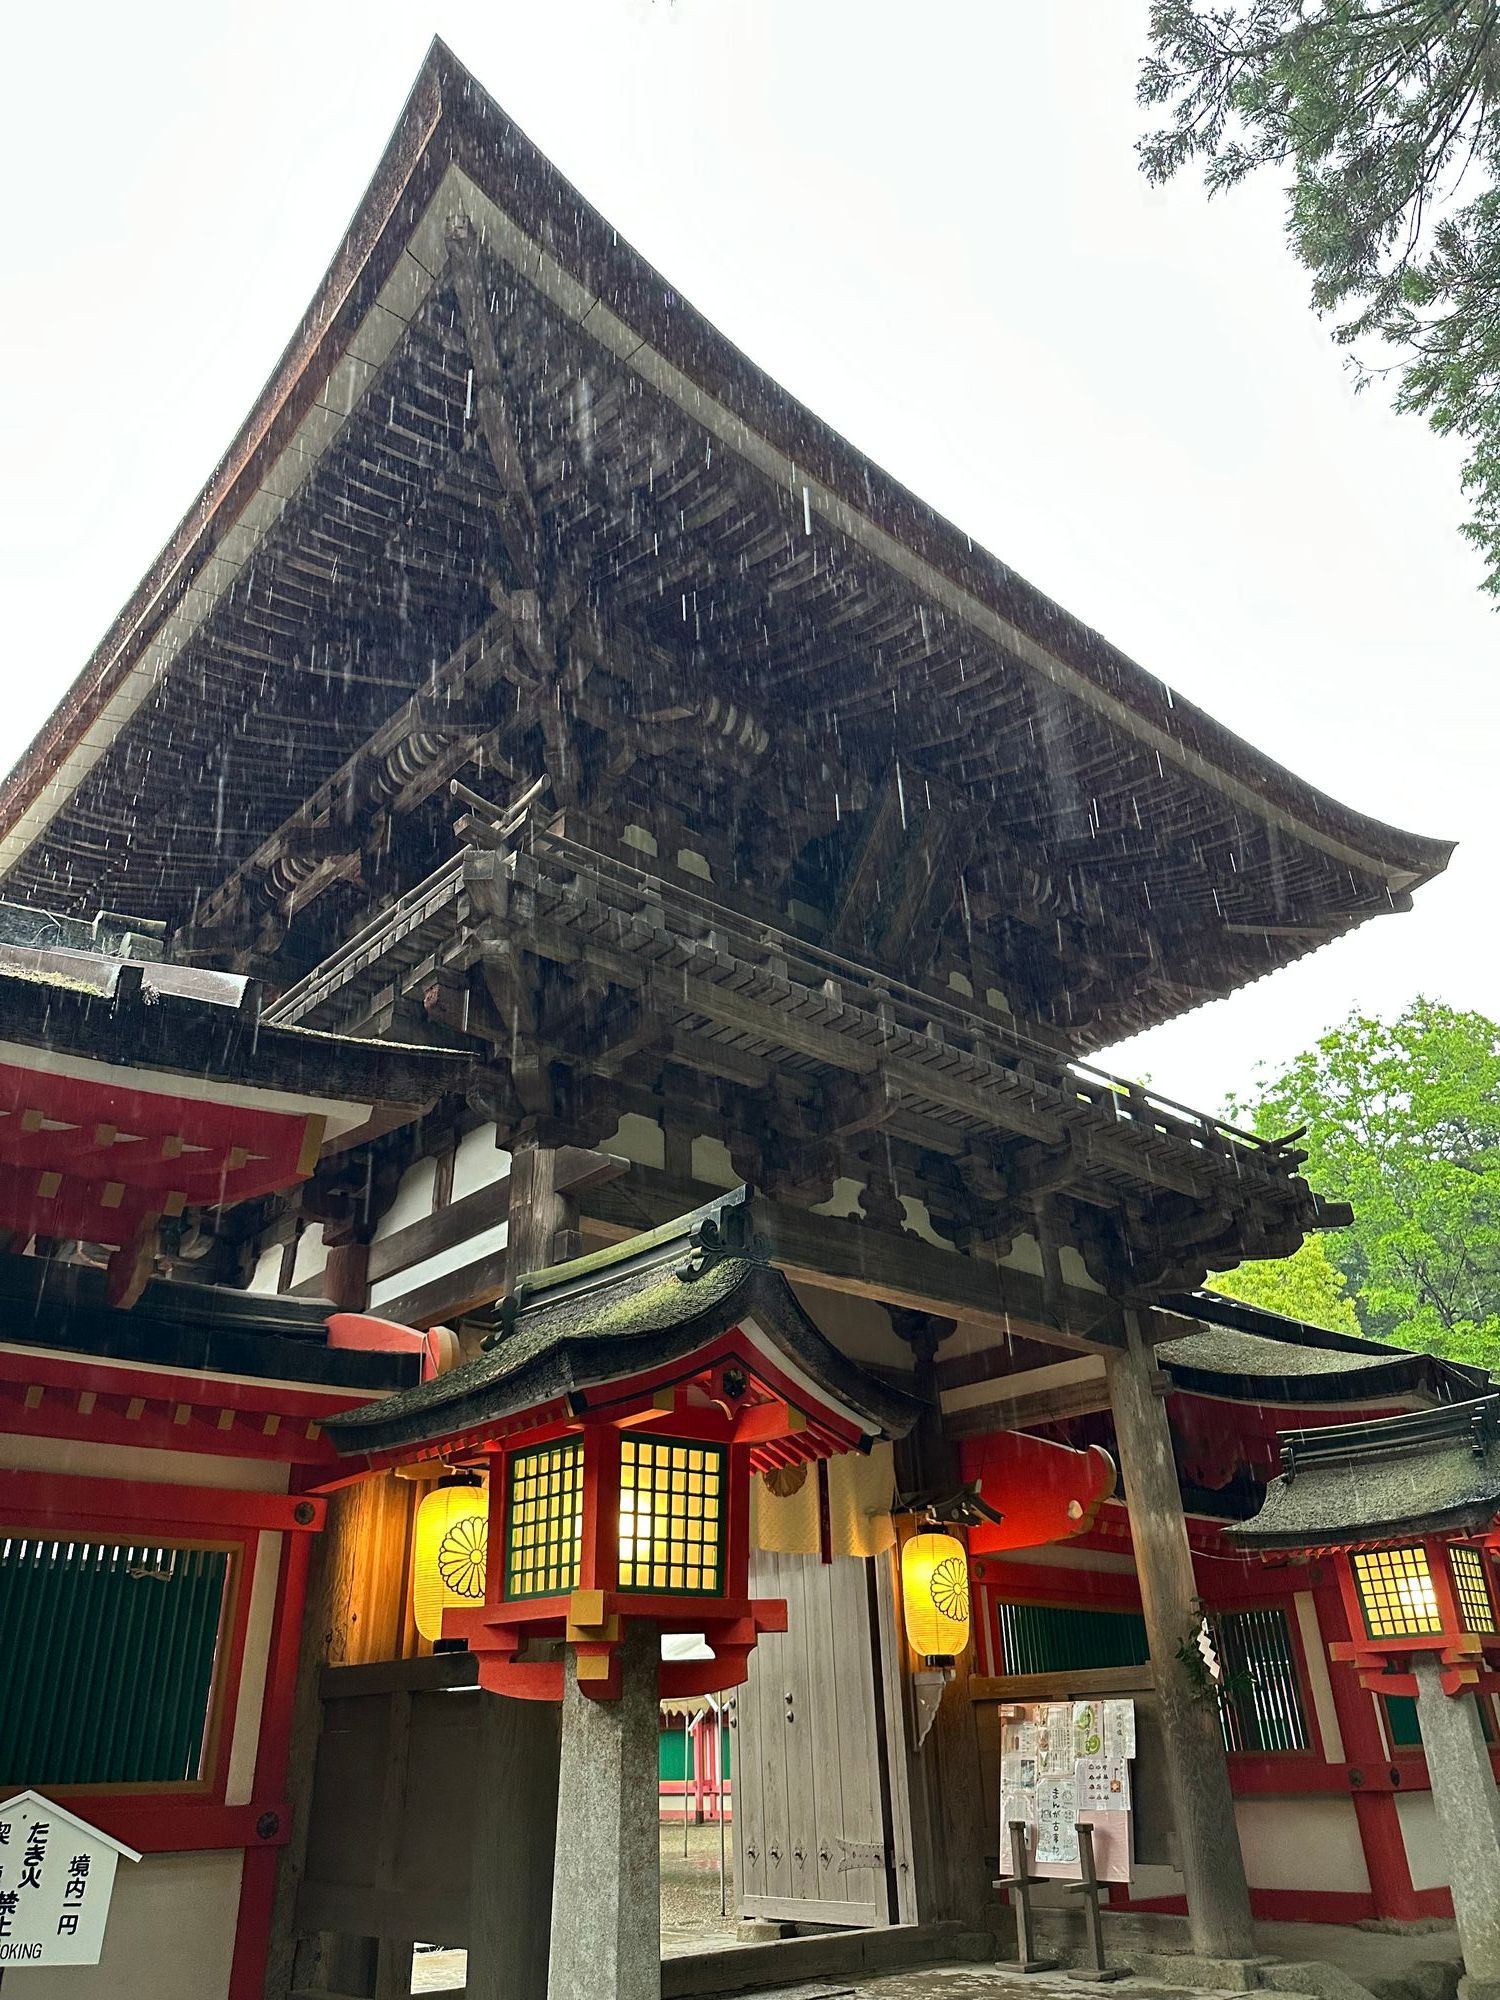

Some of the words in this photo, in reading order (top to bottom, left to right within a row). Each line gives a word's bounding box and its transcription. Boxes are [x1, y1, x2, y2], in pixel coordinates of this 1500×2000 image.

[18, 1822, 50, 1889] たき火
[57, 1854, 91, 1936] 境内一円
[0, 1943, 43, 1960] OKING
